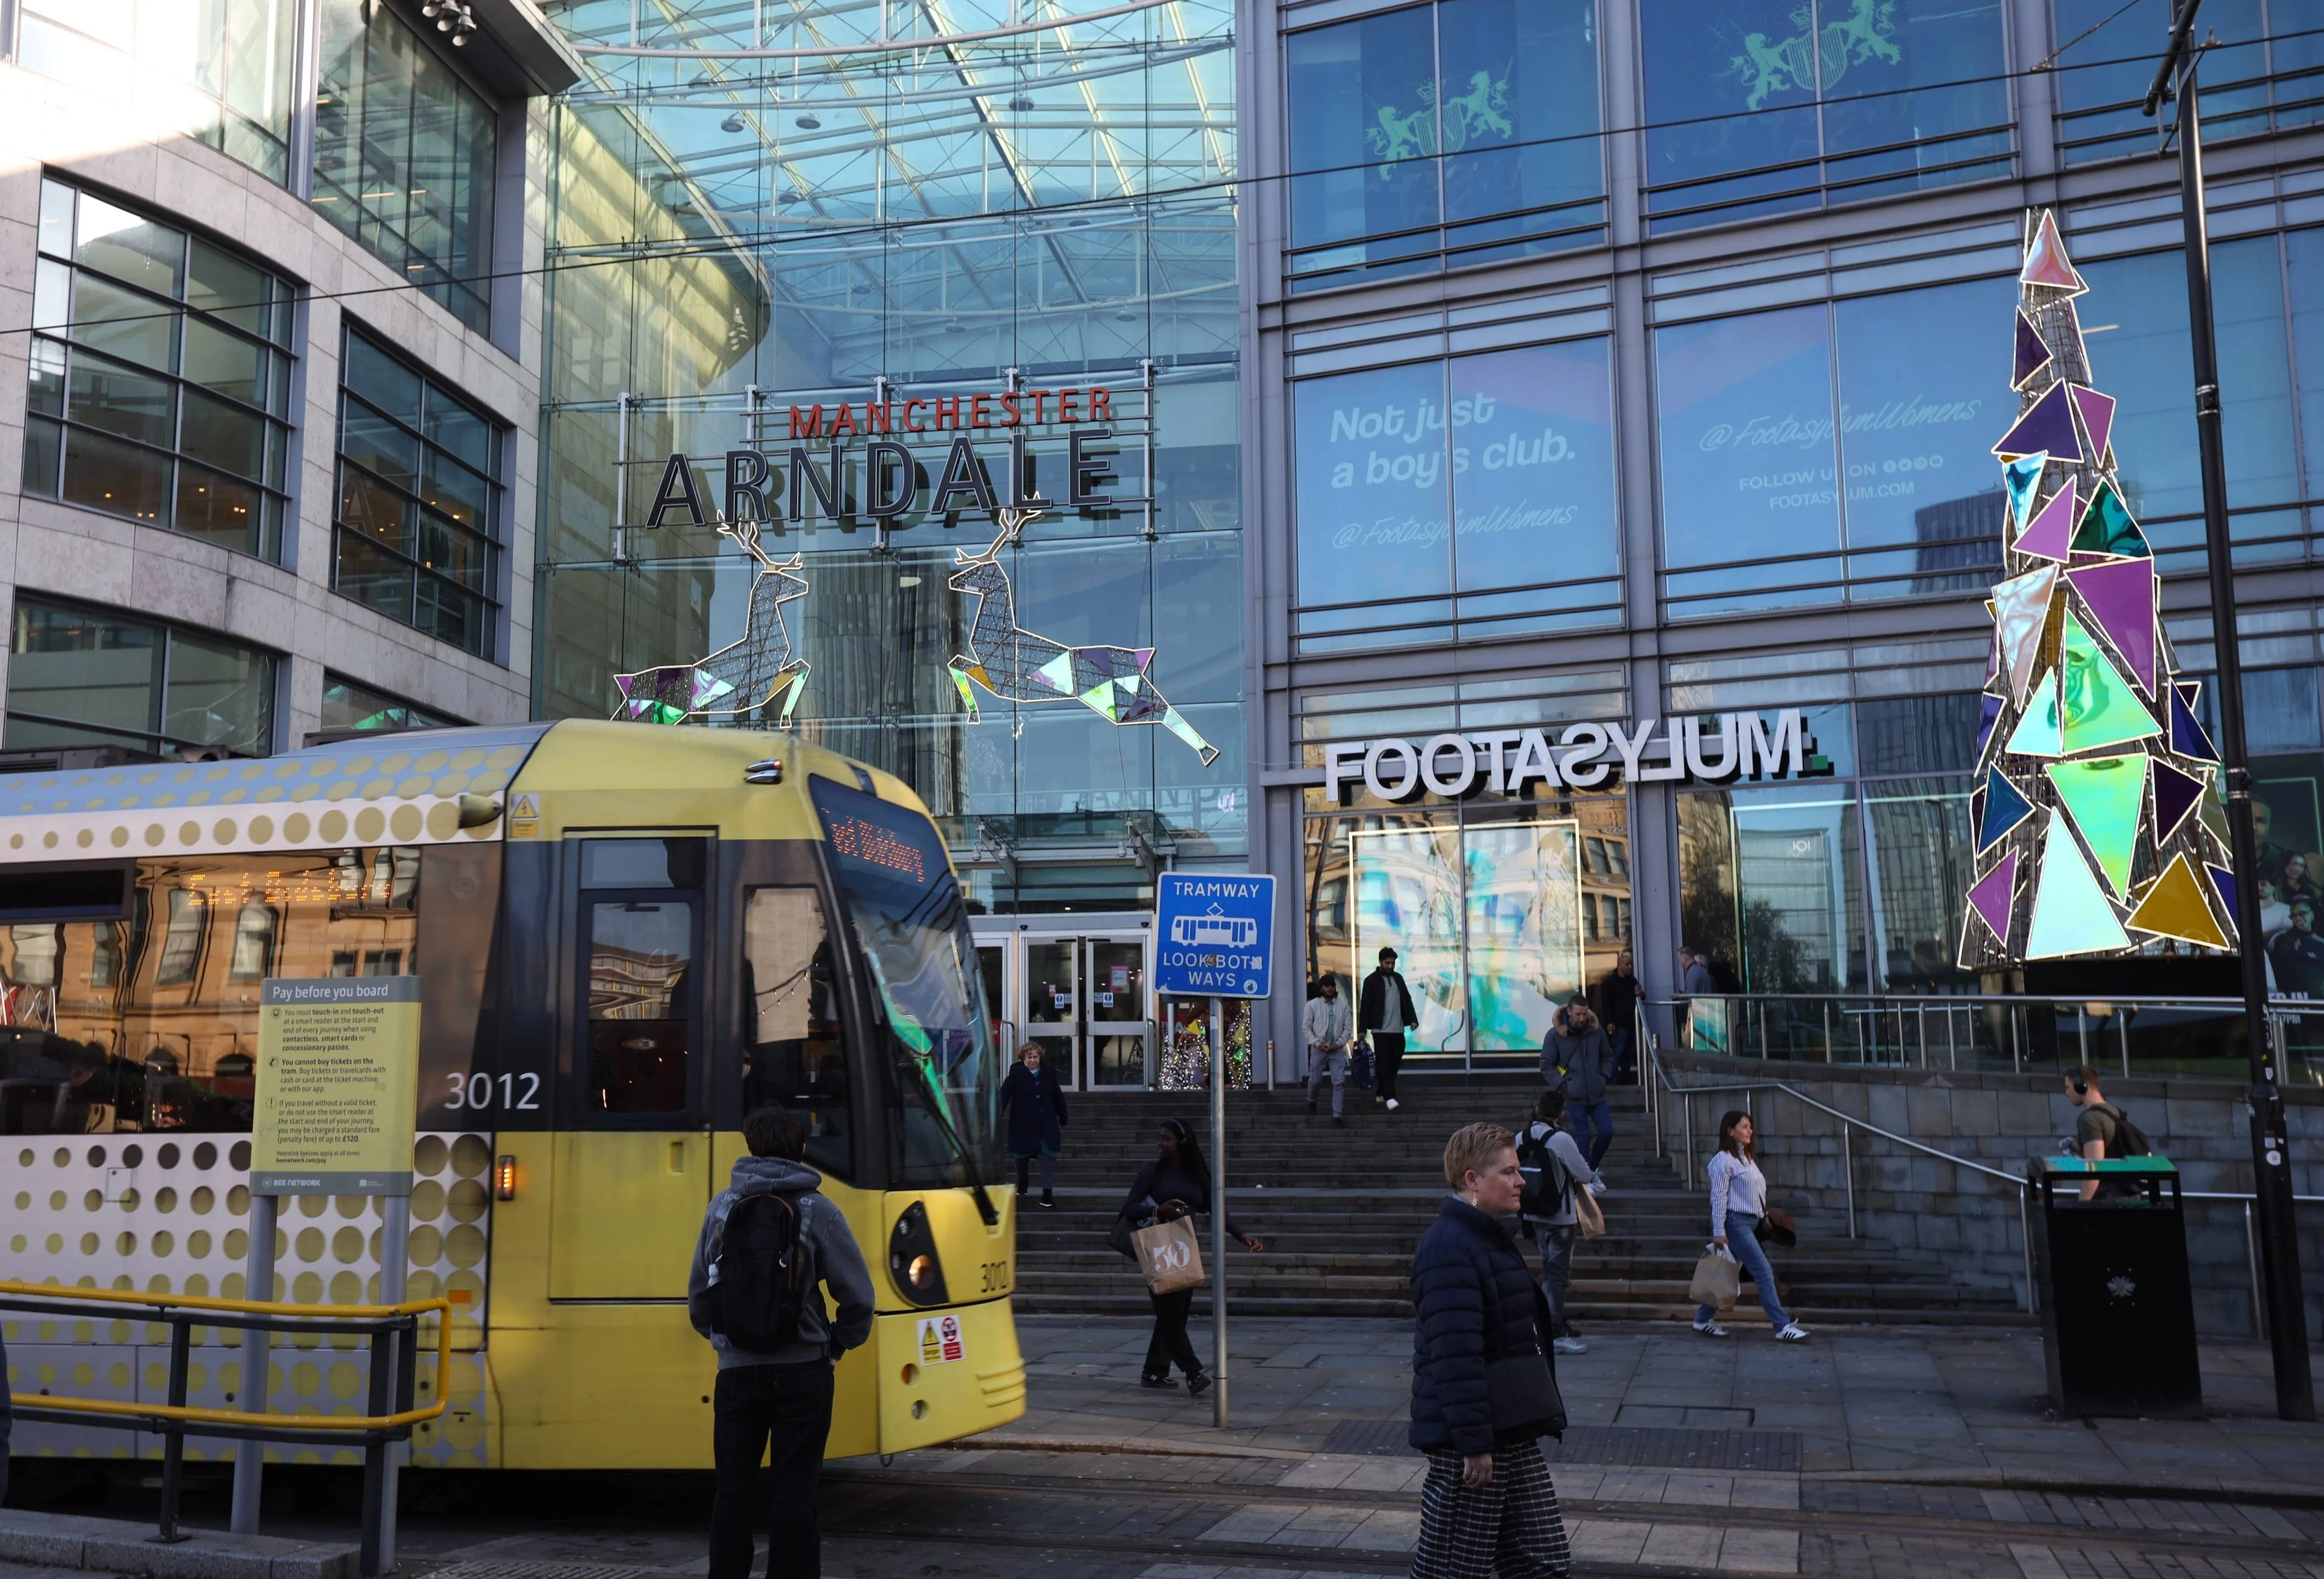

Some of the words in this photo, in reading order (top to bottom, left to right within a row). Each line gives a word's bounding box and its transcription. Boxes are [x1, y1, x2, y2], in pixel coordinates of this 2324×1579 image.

[789, 387, 1112, 439] MANCHESTER
[1330, 405, 1405, 442] Not
[1403, 392, 1495, 443] just
[1331, 462, 1354, 489] a
[1482, 428, 1575, 470] club.
[645, 428, 1112, 529] ARNDALE
[1740, 470, 1815, 490] FOLLOW
[1820, 467, 1837, 481] U
[1849, 463, 1876, 477] ON
[1326, 708, 1804, 802] FOOTASYLUM
[1174, 882, 1260, 898] TRAMWAY
[1163, 952, 1207, 967] LOOK
[1217, 955, 1262, 970] BOT
[1188, 971, 1236, 987] WAYS
[273, 987, 292, 1002] Pay
[295, 985, 331, 998] before
[333, 988, 353, 1000] you
[356, 984, 388, 996] board
[320, 1026, 341, 1034] journey
[318, 1058, 329, 1066] buy
[444, 1072, 540, 1110] 3012
[312, 1126, 335, 1134] charged
